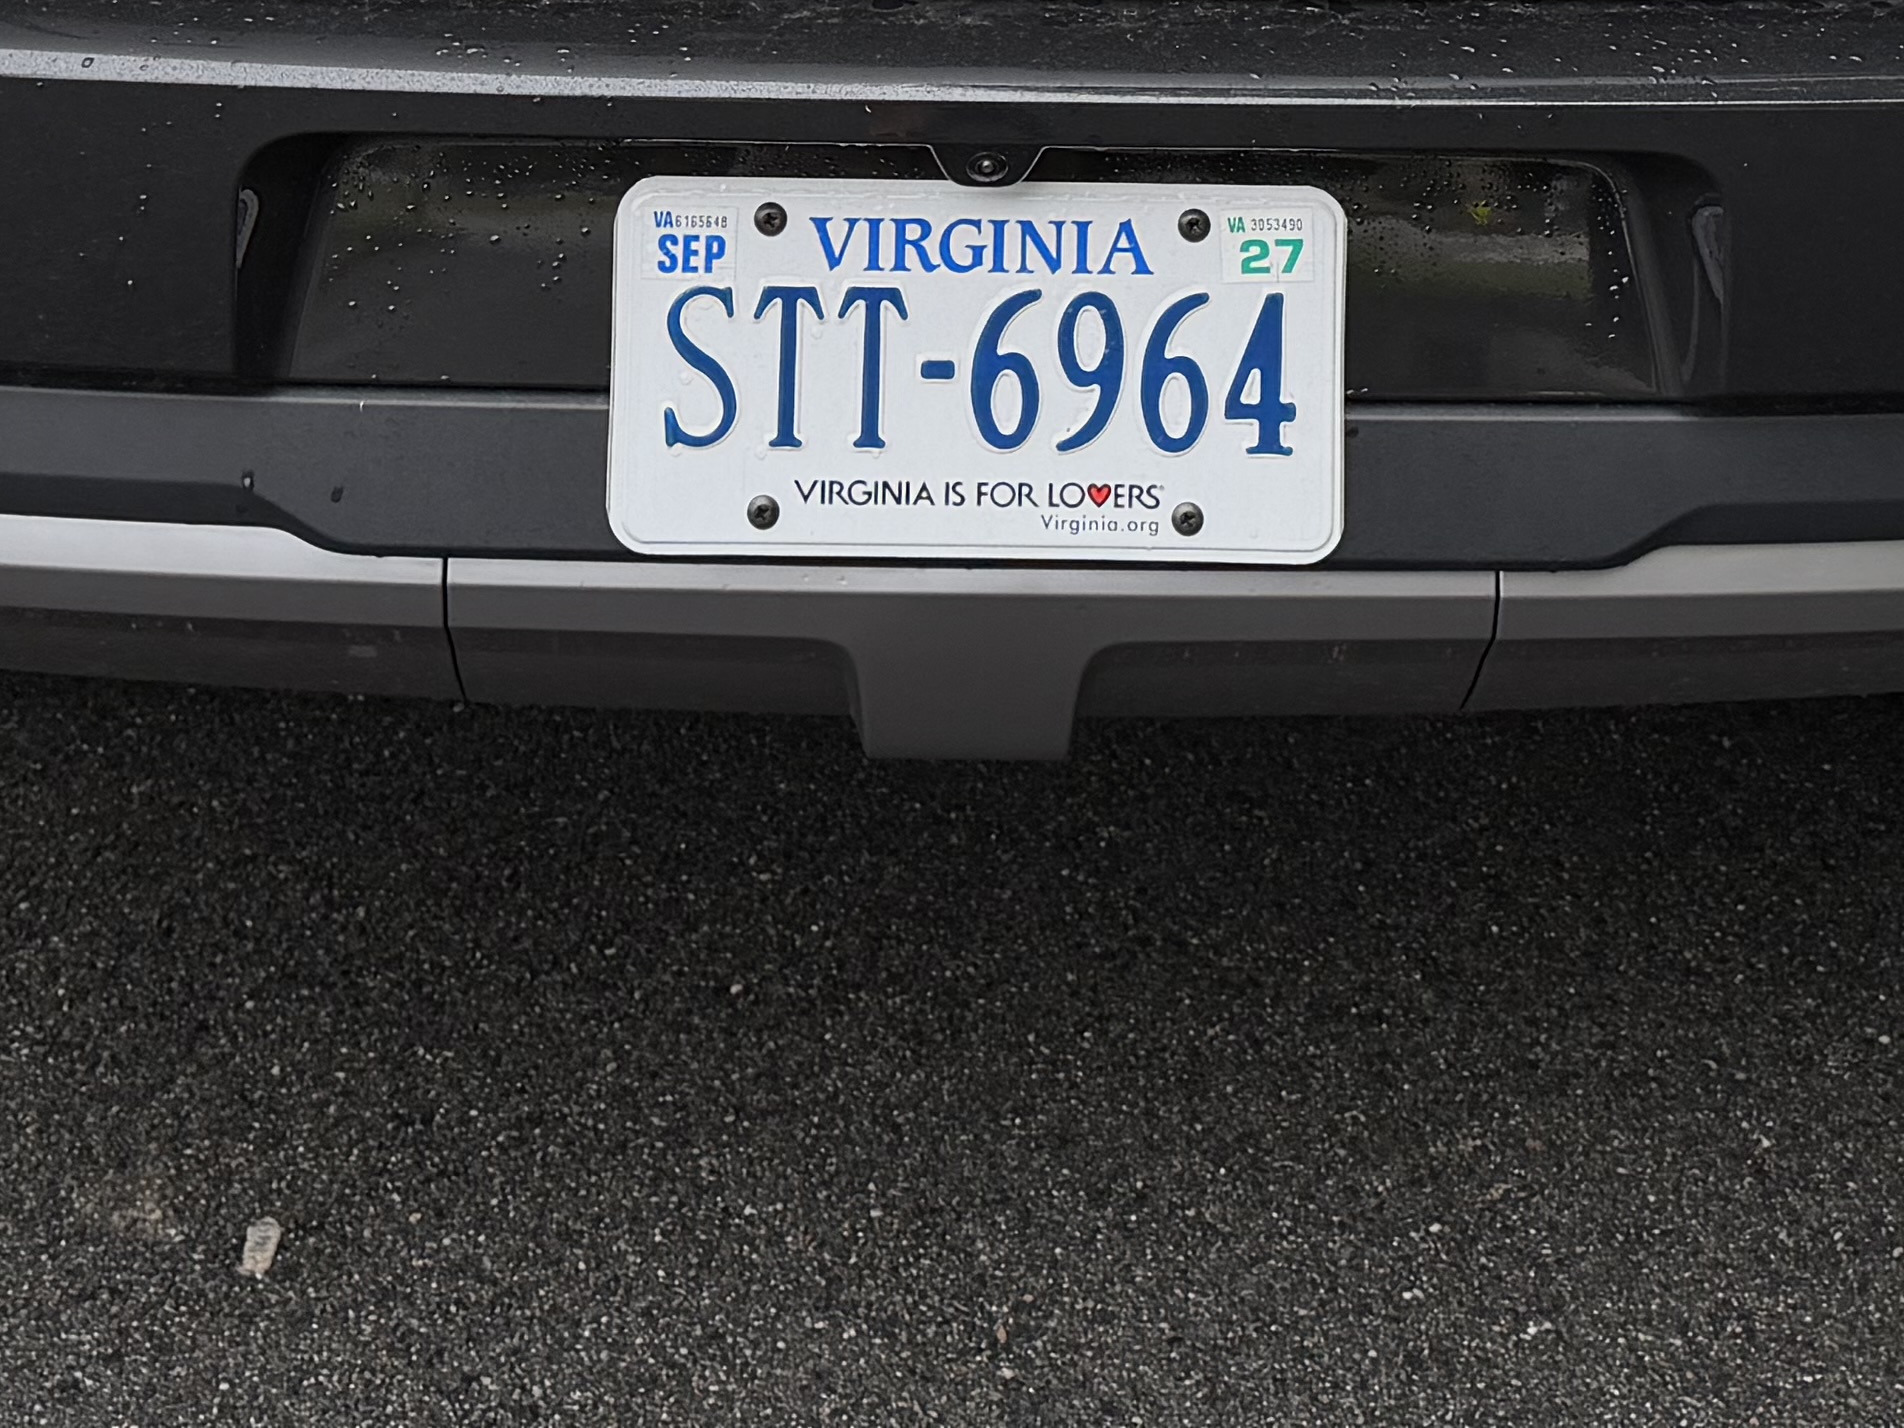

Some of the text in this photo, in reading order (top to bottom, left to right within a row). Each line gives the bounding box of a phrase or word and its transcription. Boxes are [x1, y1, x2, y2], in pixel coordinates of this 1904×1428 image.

[653, 210, 674, 229] VA
[1227, 216, 1246, 234] VA
[657, 233, 728, 274] SEP
[808, 217, 1154, 276] VIRGINIA
[1239, 238, 1305, 275] 27
[663, 286, 1298, 456] STT-6964
[794, 479, 937, 507] VIRGINIA
[944, 480, 966, 507] IS
[976, 481, 1040, 508] FOR
[1040, 514, 1160, 536] Virginia.org
